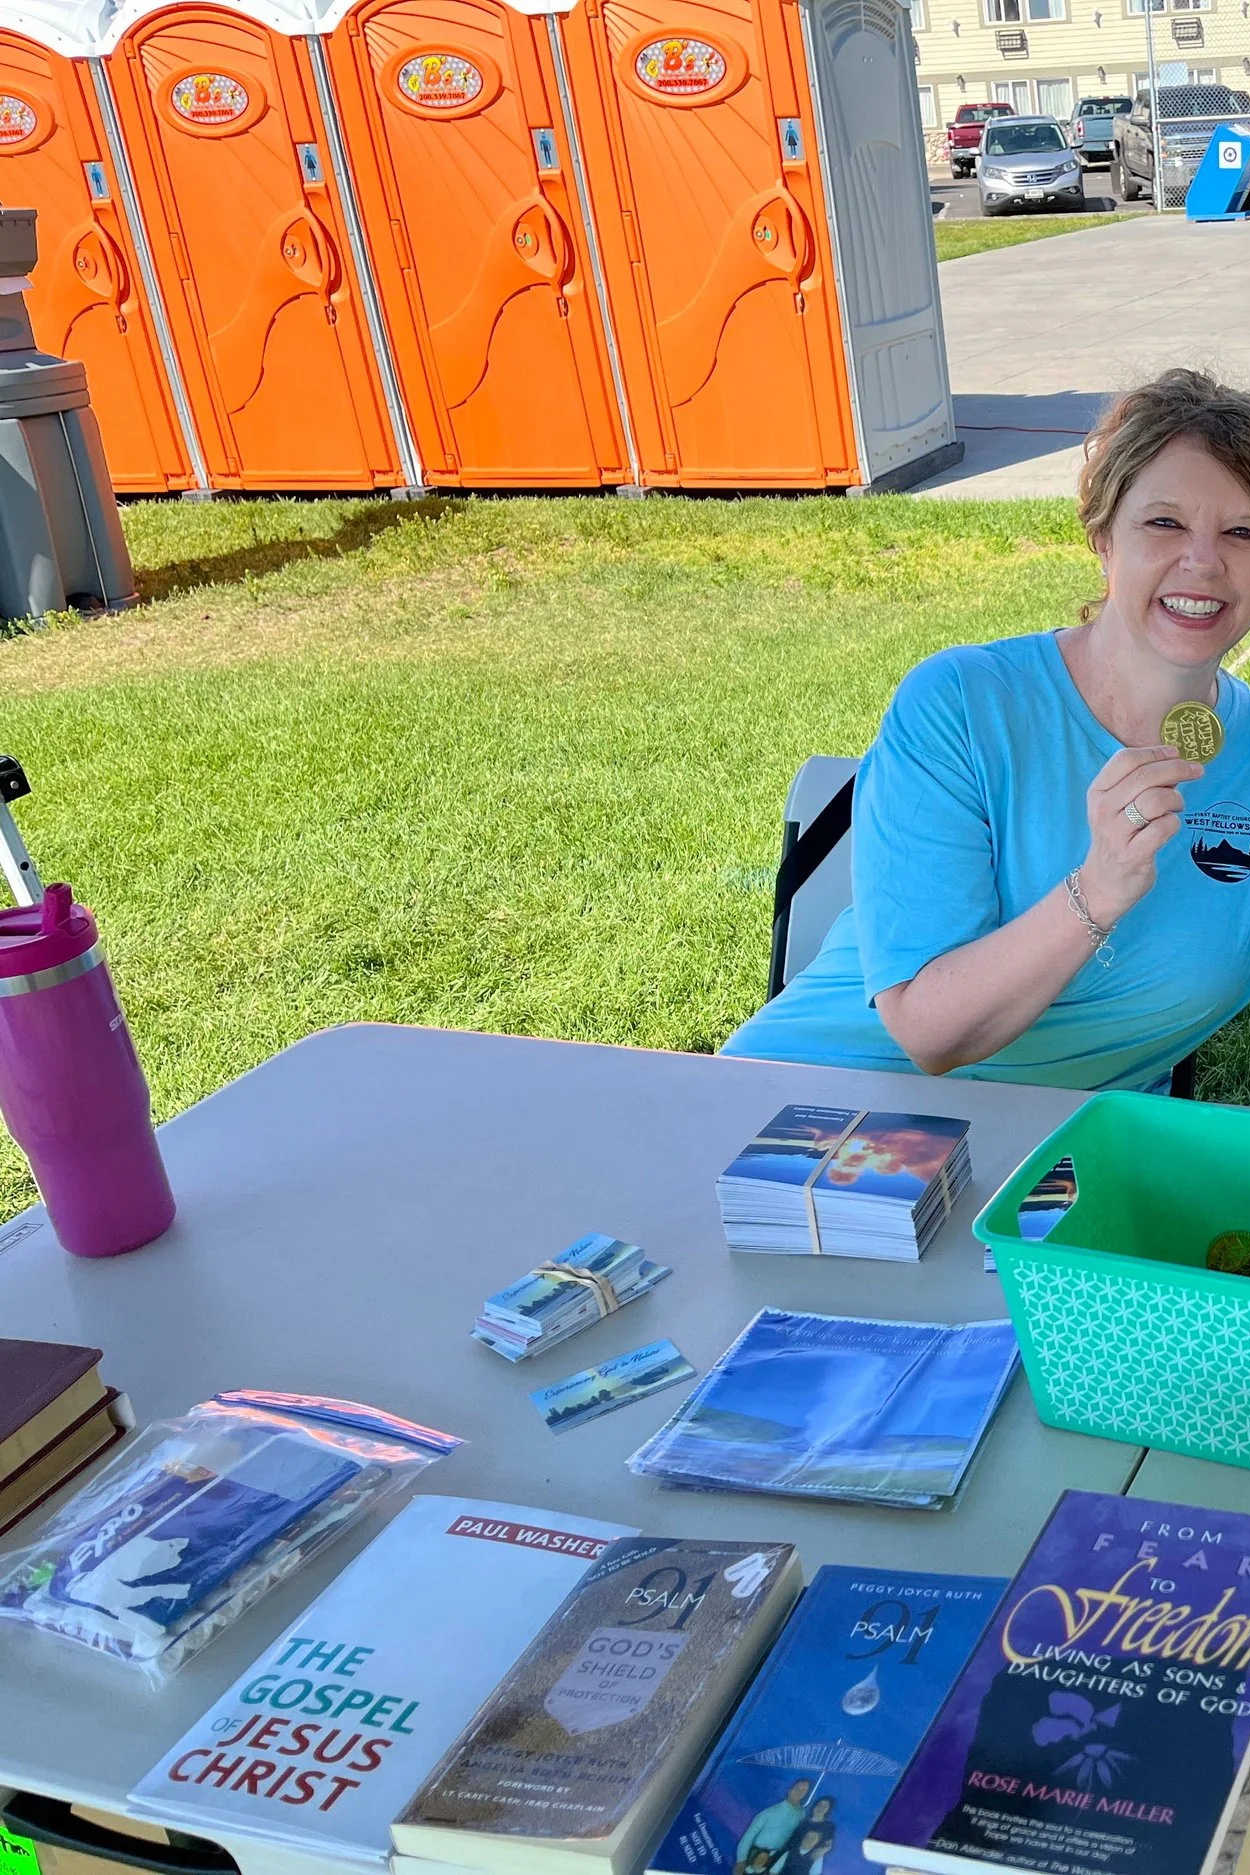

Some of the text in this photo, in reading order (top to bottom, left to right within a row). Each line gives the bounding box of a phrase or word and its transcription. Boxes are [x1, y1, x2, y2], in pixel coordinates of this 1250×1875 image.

[1184, 818, 1211, 826] WEST
[69, 1503, 144, 1571] EXPO
[454, 1519, 607, 1557] PAUL WASHER
[1140, 1520, 1224, 1545] FROM
[617, 1566, 717, 1630] 91
[624, 1587, 706, 1610] PSALM
[850, 1583, 982, 1601] PEGGY JOYCE RUTH
[1150, 1577, 1176, 1594] TO
[845, 1600, 942, 1665] 91
[850, 1621, 934, 1644] PSALM
[275, 1637, 376, 1677] THE
[587, 1637, 680, 1661] GOD'S
[577, 1660, 657, 1680] SHIELD
[1007, 1660, 1148, 1698] DAUGHTERS
[1157, 1687, 1190, 1705] OF
[1031, 1641, 1247, 1695] LIVING AS SONS &
[557, 1687, 642, 1705] PROTECTION
[598, 1680, 618, 1689] OF
[239, 1674, 421, 1735] GOSPEL
[211, 1714, 393, 1772] OF JESUS
[168, 1748, 362, 1812] CHRIST
[498, 1780, 571, 1794] FOREWORD BY
[967, 1769, 1176, 1825] ROSE MARIE MILLER
